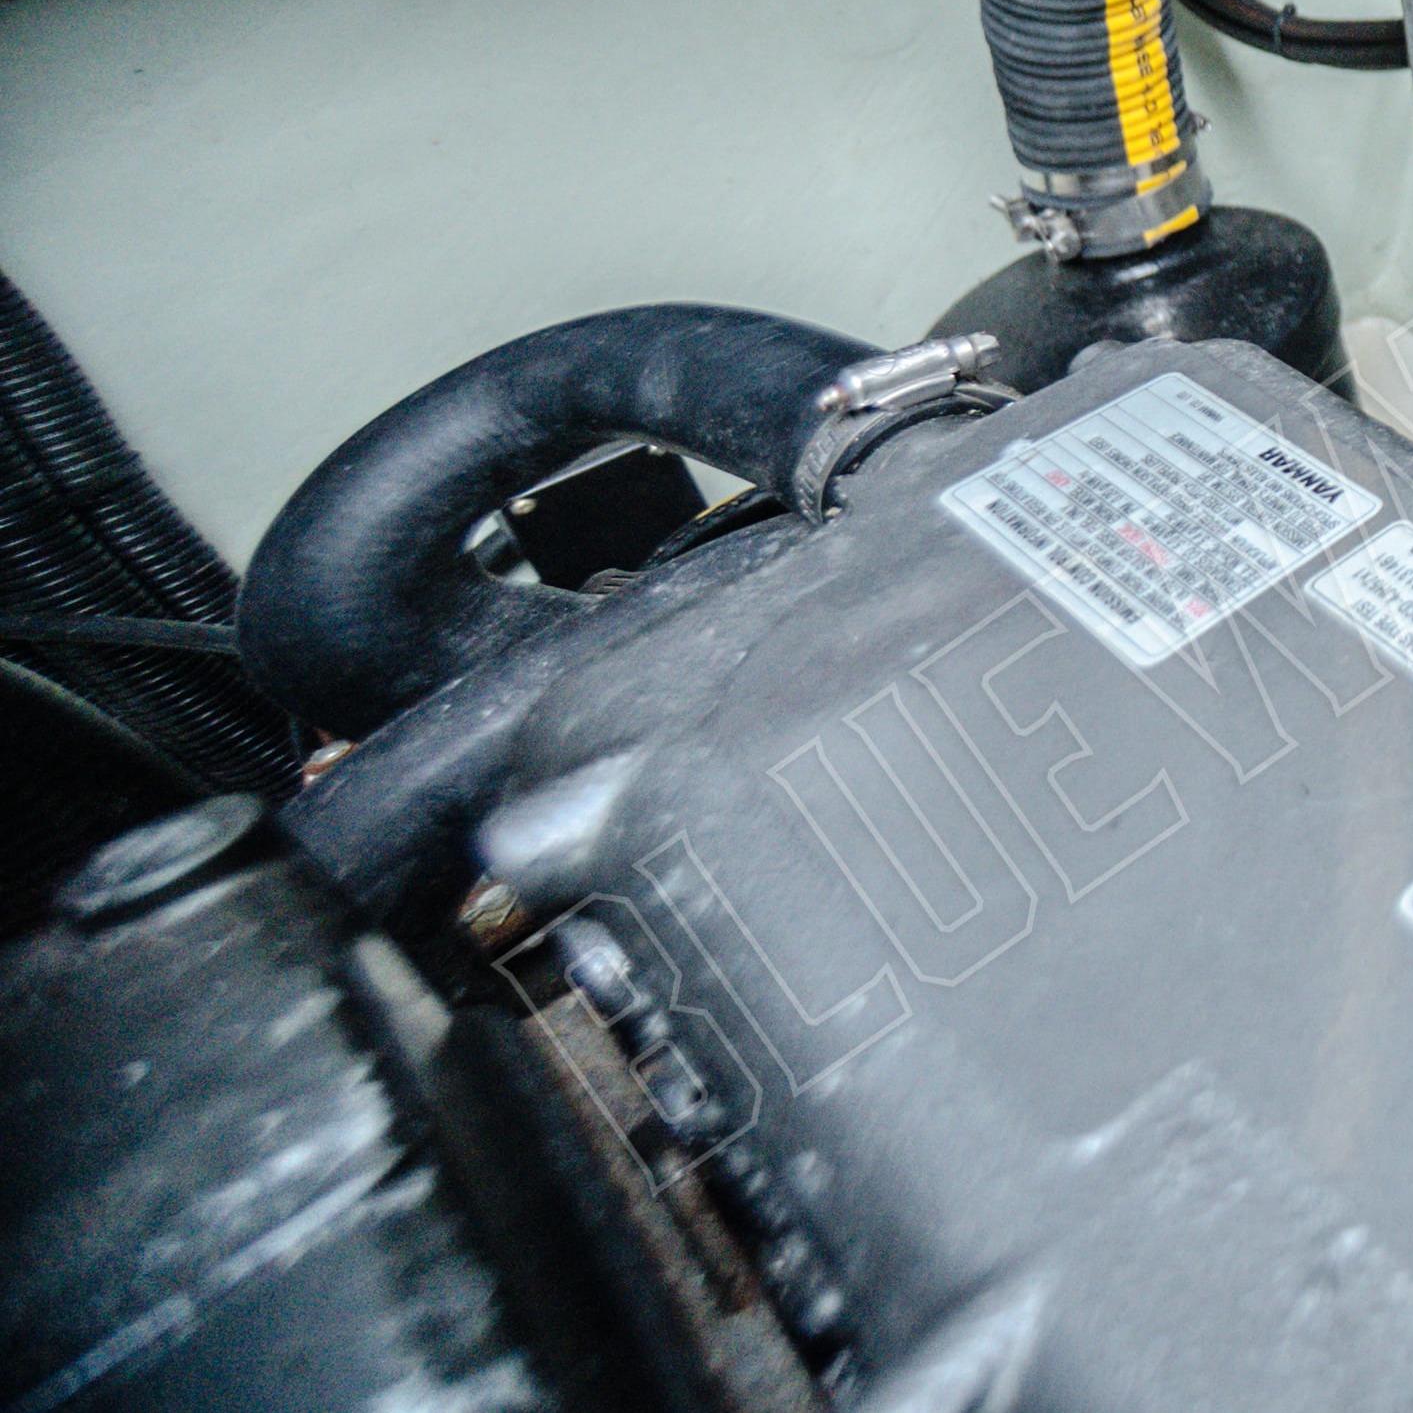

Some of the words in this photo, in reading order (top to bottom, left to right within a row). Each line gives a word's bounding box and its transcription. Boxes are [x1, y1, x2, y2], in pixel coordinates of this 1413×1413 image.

[1257, 441, 1345, 506] YANMAR
[983, 495, 1055, 554] INFORMATION
[1043, 543, 1094, 585] CONTROL
[1084, 576, 1146, 626] EMISSION
[1349, 594, 1380, 621] TEST
[1372, 611, 1405, 640] TYPE
